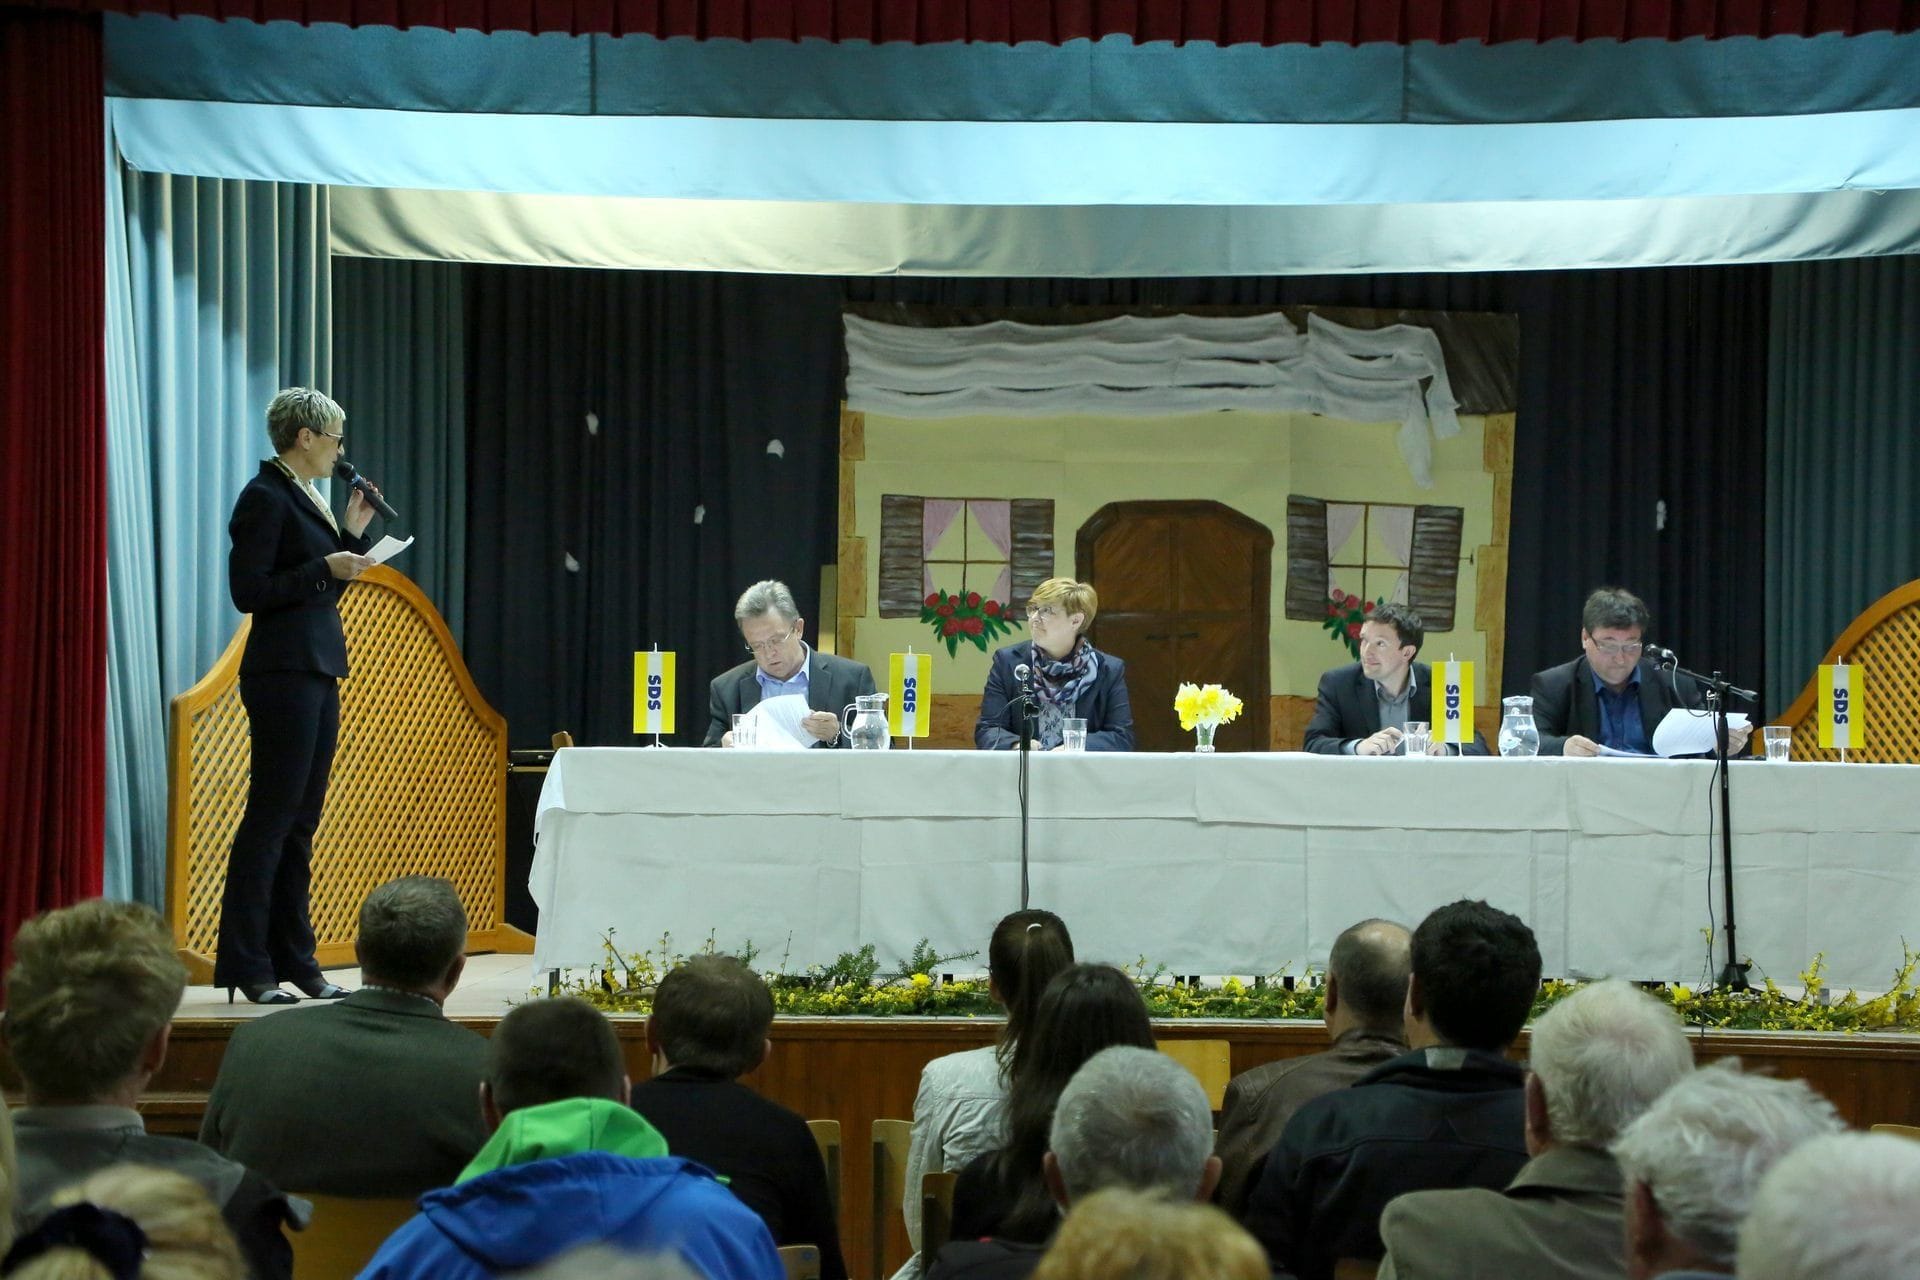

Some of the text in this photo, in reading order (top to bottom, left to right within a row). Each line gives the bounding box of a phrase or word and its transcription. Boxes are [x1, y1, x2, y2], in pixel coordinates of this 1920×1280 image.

[648, 674, 661, 711] SDS
[903, 677, 917, 713] SDS
[1446, 684, 1460, 721] SDS
[1834, 687, 1848, 725] SDS
